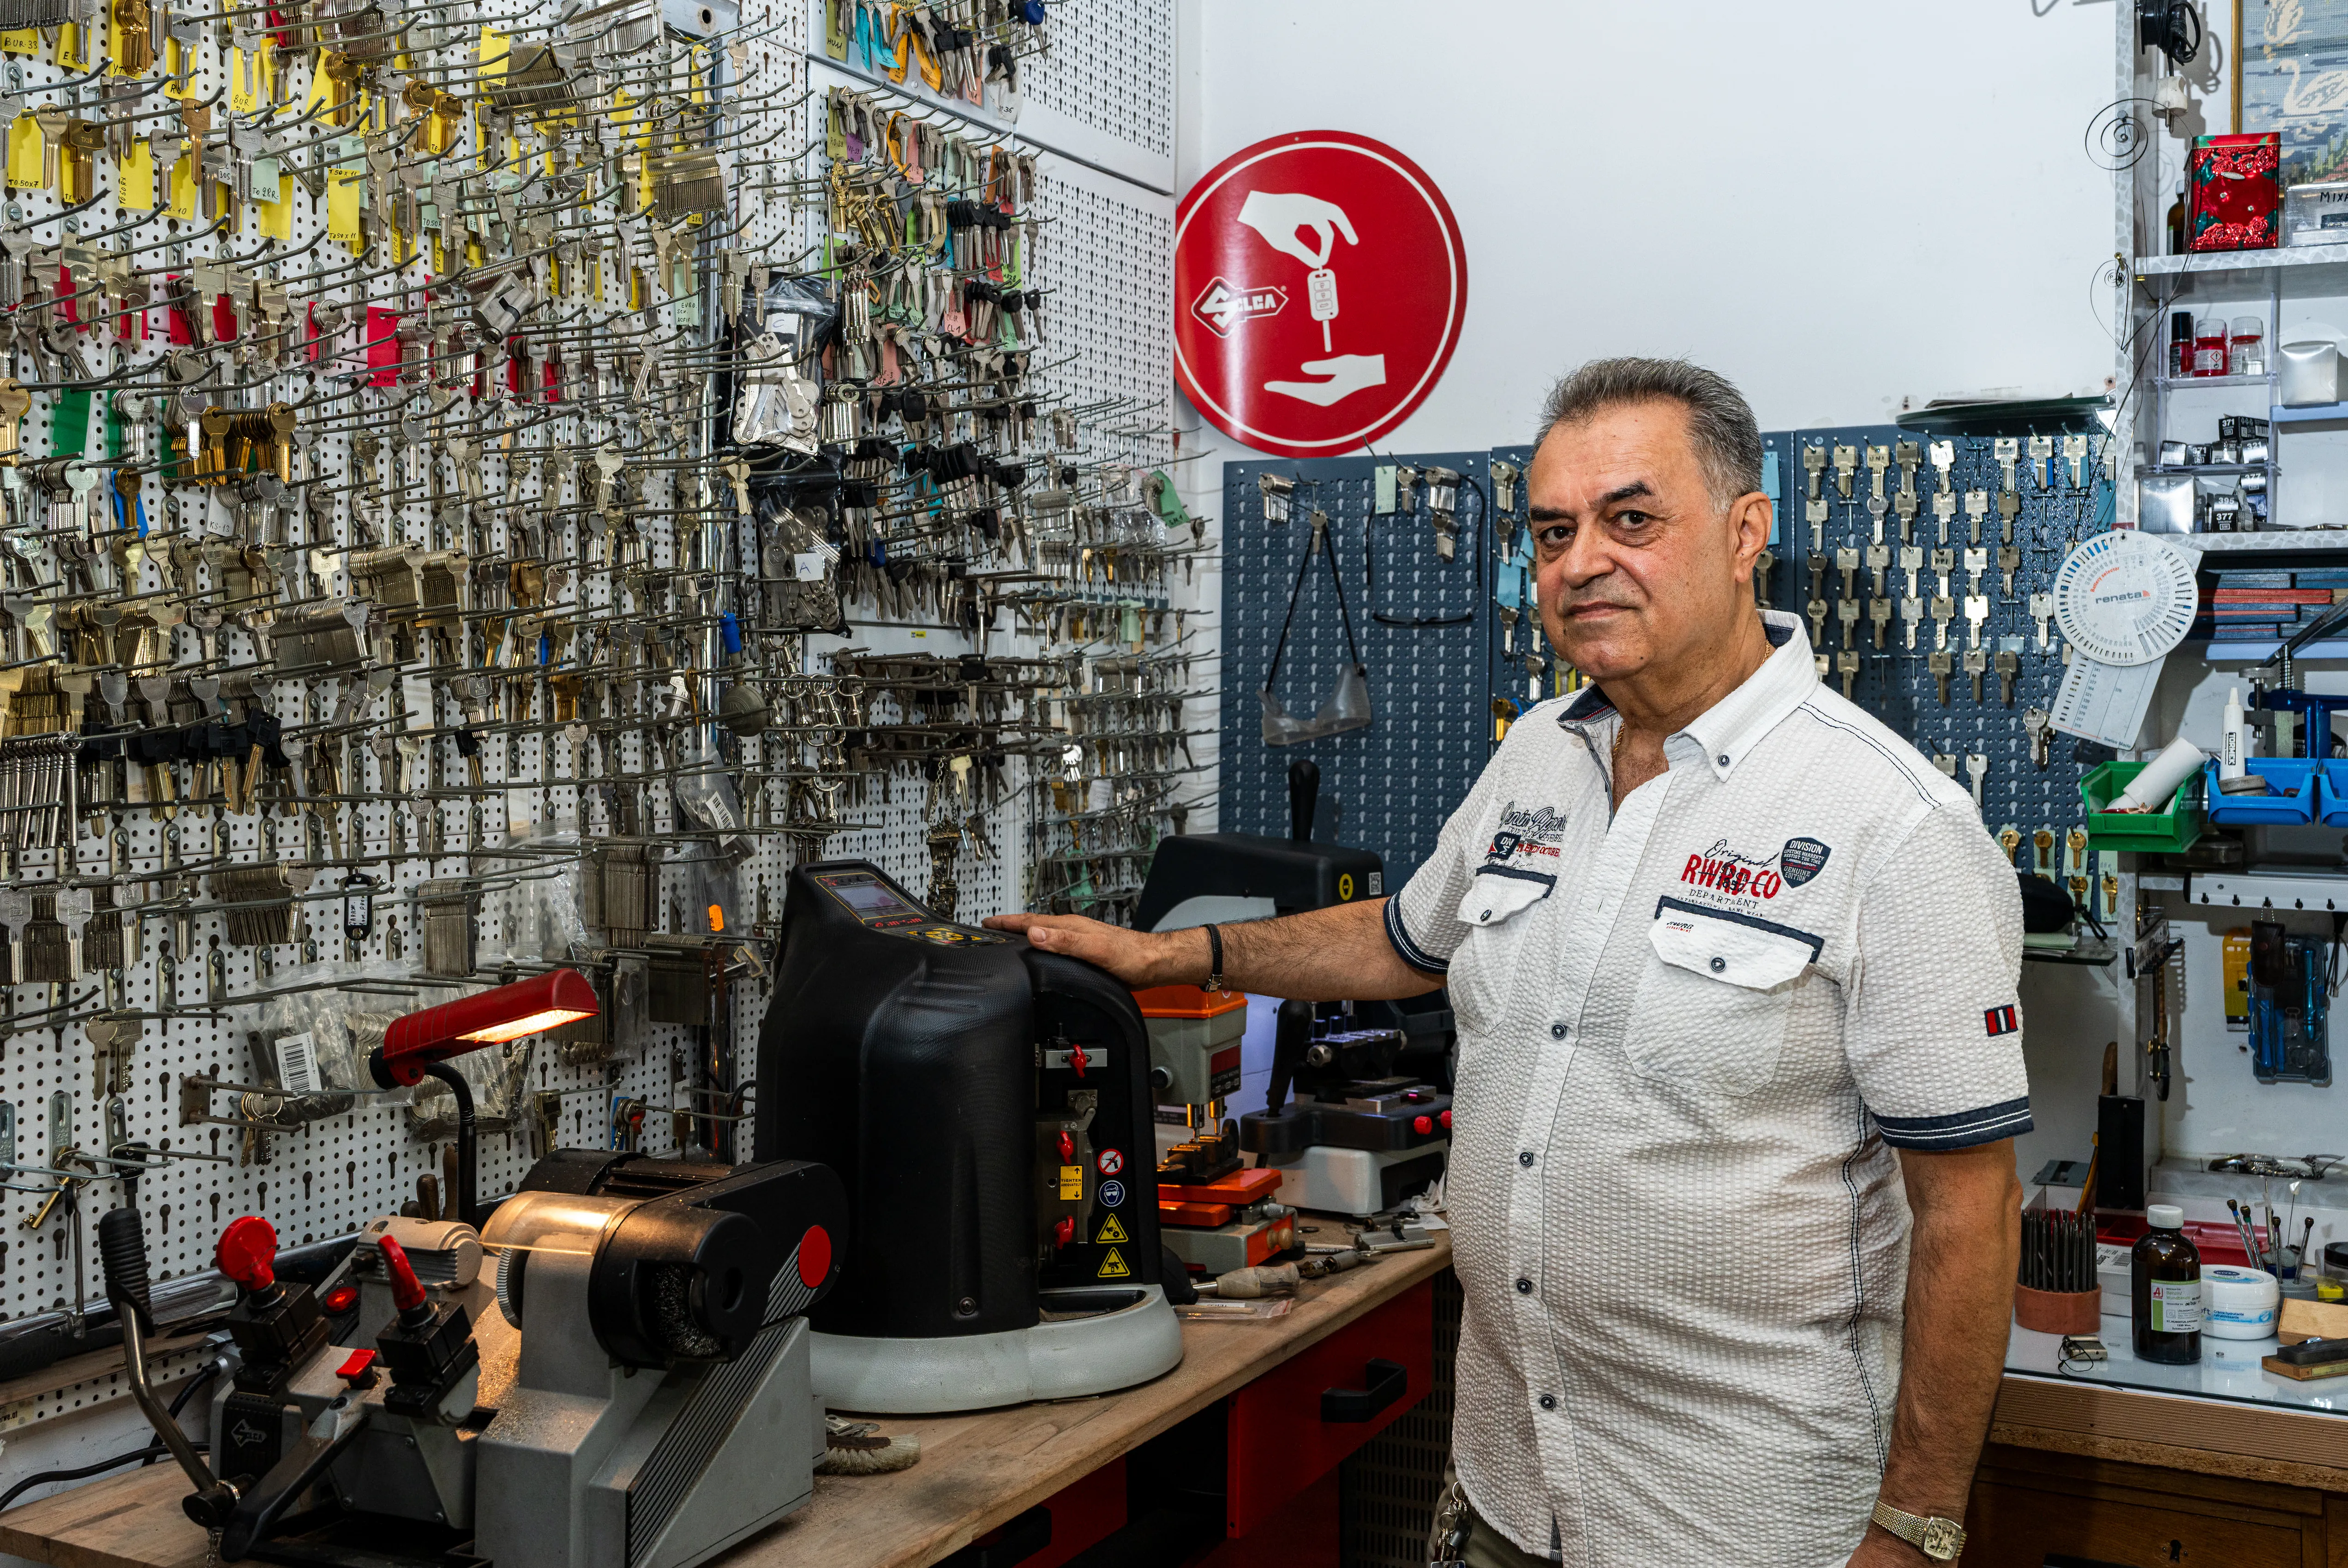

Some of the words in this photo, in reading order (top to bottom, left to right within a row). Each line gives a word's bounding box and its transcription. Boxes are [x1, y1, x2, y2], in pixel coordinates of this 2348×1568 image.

[234, 95, 250, 107] BUR
[2222, 419, 2234, 427] 371
[2247, 441, 2262, 450] 321
[2216, 513, 2233, 521] 377
[210, 521, 230, 532] KS-13
[800, 562, 811, 574] A
[2090, 577, 2102, 592] Battery
[2101, 567, 2120, 577] selector
[2095, 591, 2142, 604] renata
[1789, 840, 1823, 855] DIVISION
[1704, 839, 1780, 869] Original
[1802, 851, 1825, 861] WARRENTY
[1784, 866, 1811, 877] GENUINE
[1785, 872, 1806, 882] EDITION
[1689, 889, 1759, 909] DEPARTMENT
